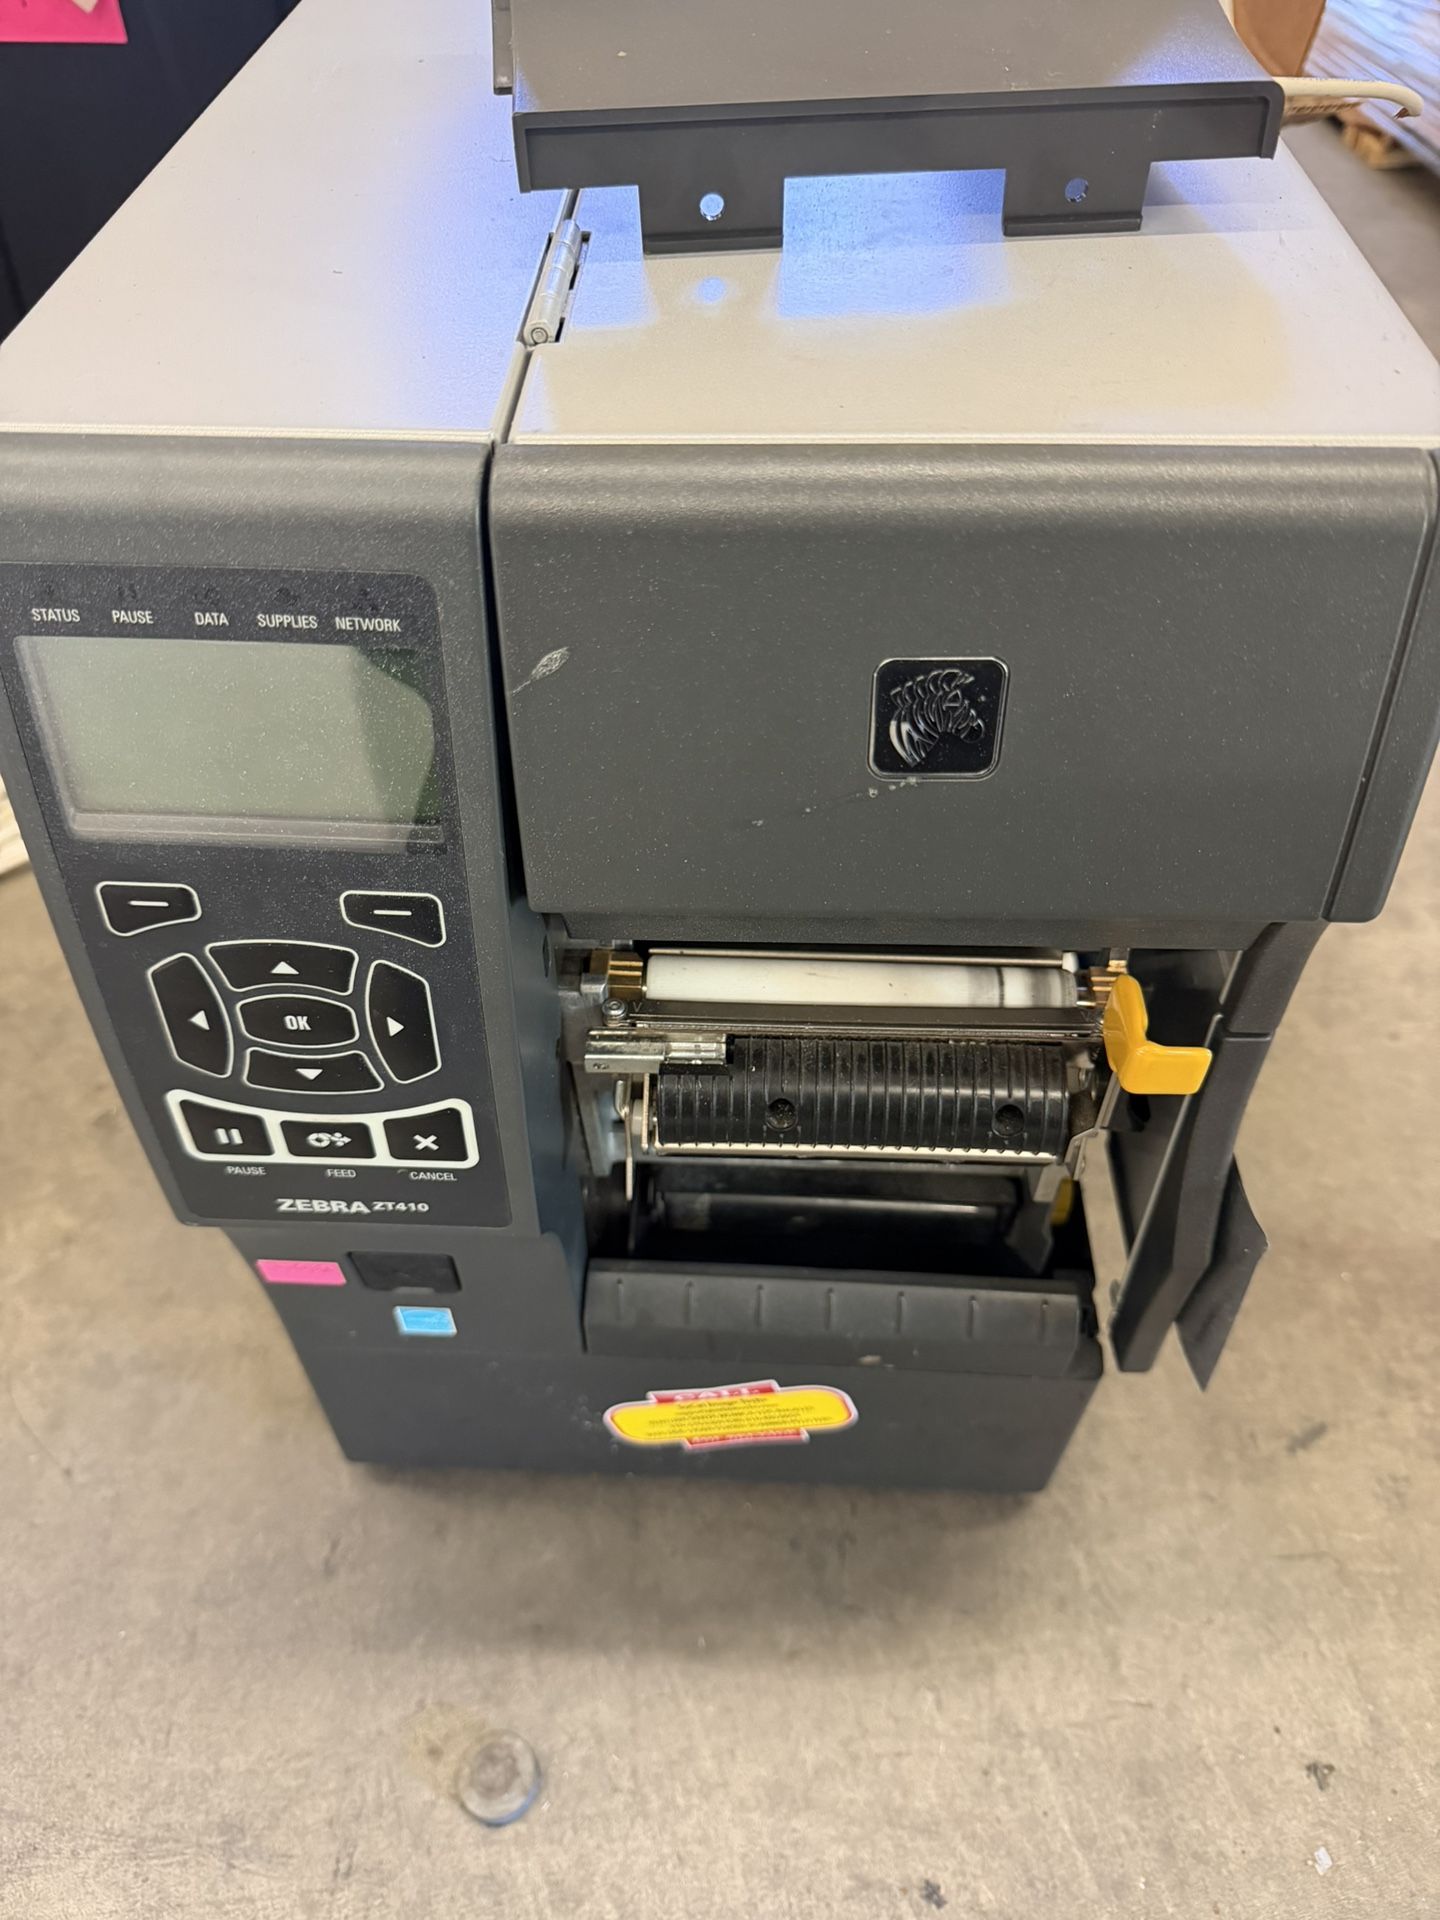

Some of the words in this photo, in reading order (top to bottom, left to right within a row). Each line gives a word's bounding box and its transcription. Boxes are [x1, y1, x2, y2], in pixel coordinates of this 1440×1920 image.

[32, 608, 80, 622] STATUS
[112, 610, 154, 624] PAUSE
[194, 612, 229, 626] DATA
[257, 614, 318, 629] SUPPLIES
[335, 617, 401, 632] NETWORK
[284, 1015, 311, 1030] OK
[225, 1166, 266, 1176] PAUSE
[326, 1168, 357, 1178] FEED
[410, 1171, 457, 1182] CANCEL
[276, 1198, 371, 1214] ZEBRA
[372, 1201, 430, 1213] ZT410
